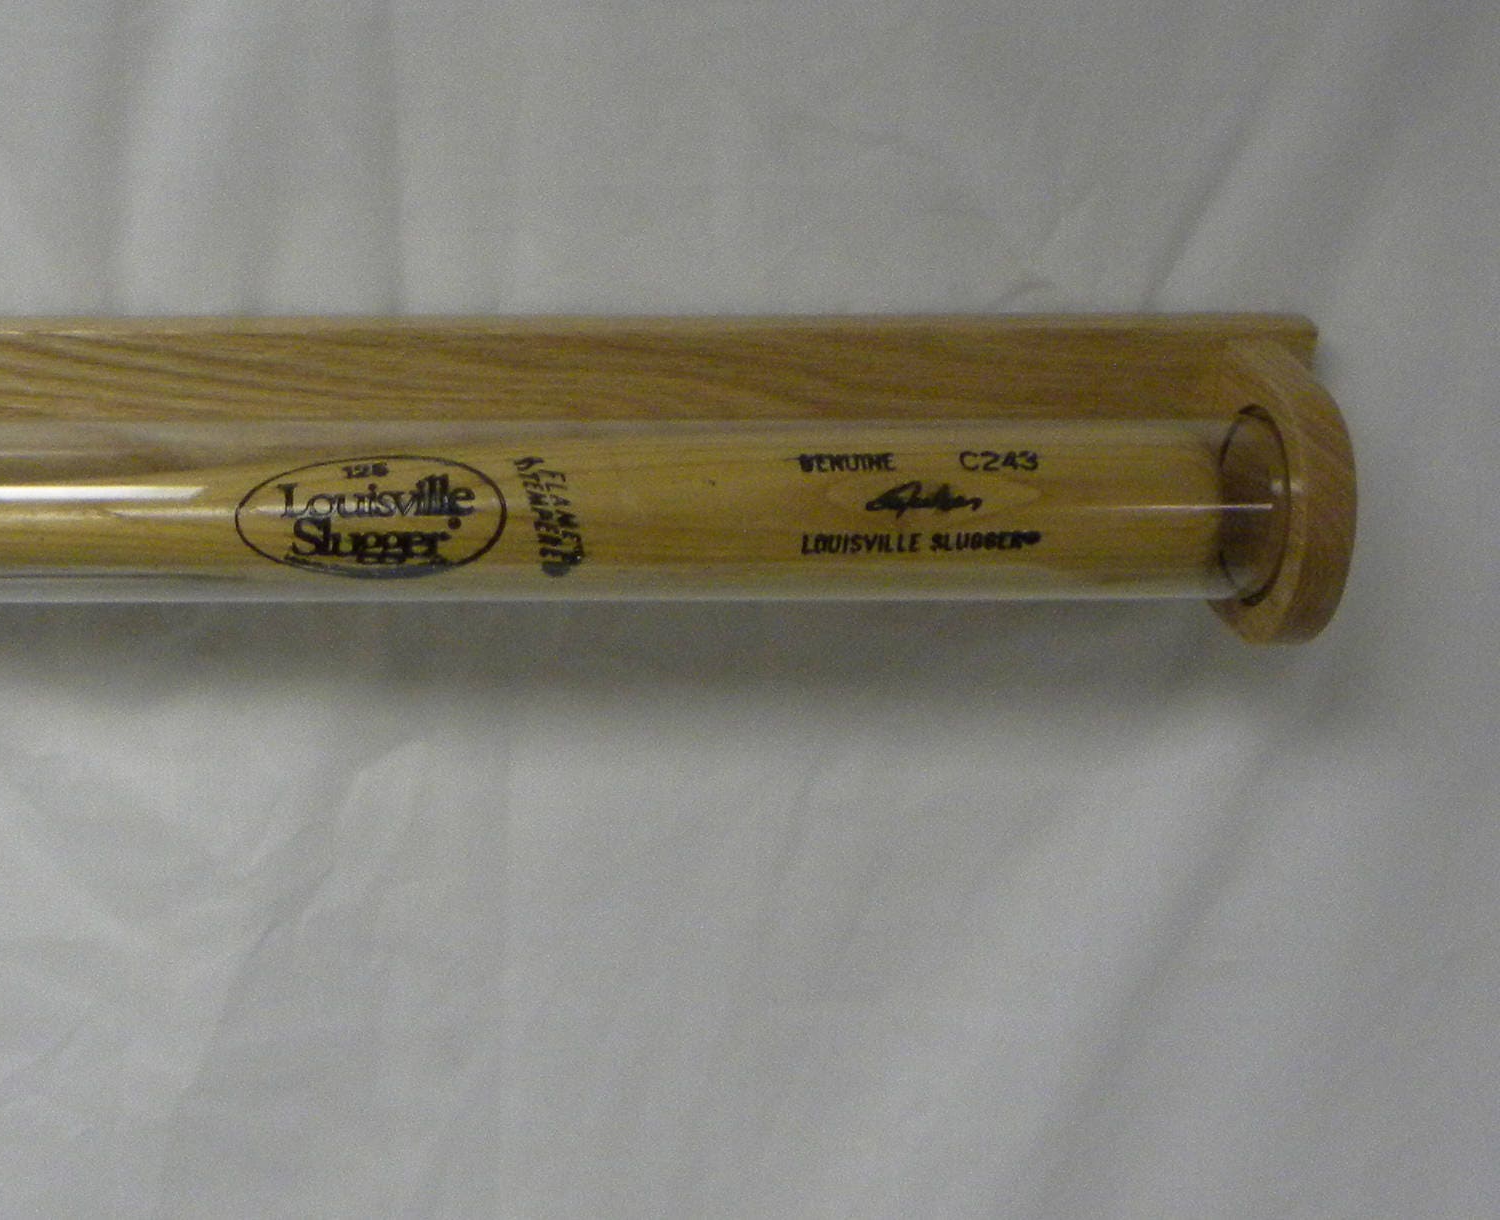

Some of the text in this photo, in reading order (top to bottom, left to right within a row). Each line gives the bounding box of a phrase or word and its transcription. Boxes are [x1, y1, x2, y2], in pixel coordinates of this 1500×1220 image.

[799, 452, 897, 473] GENUINE
[958, 450, 1040, 472] C243
[276, 473, 476, 519] Louisville
[290, 516, 451, 565] Slugger
[800, 530, 1024, 556] LOUISVILLE SLUGGER
